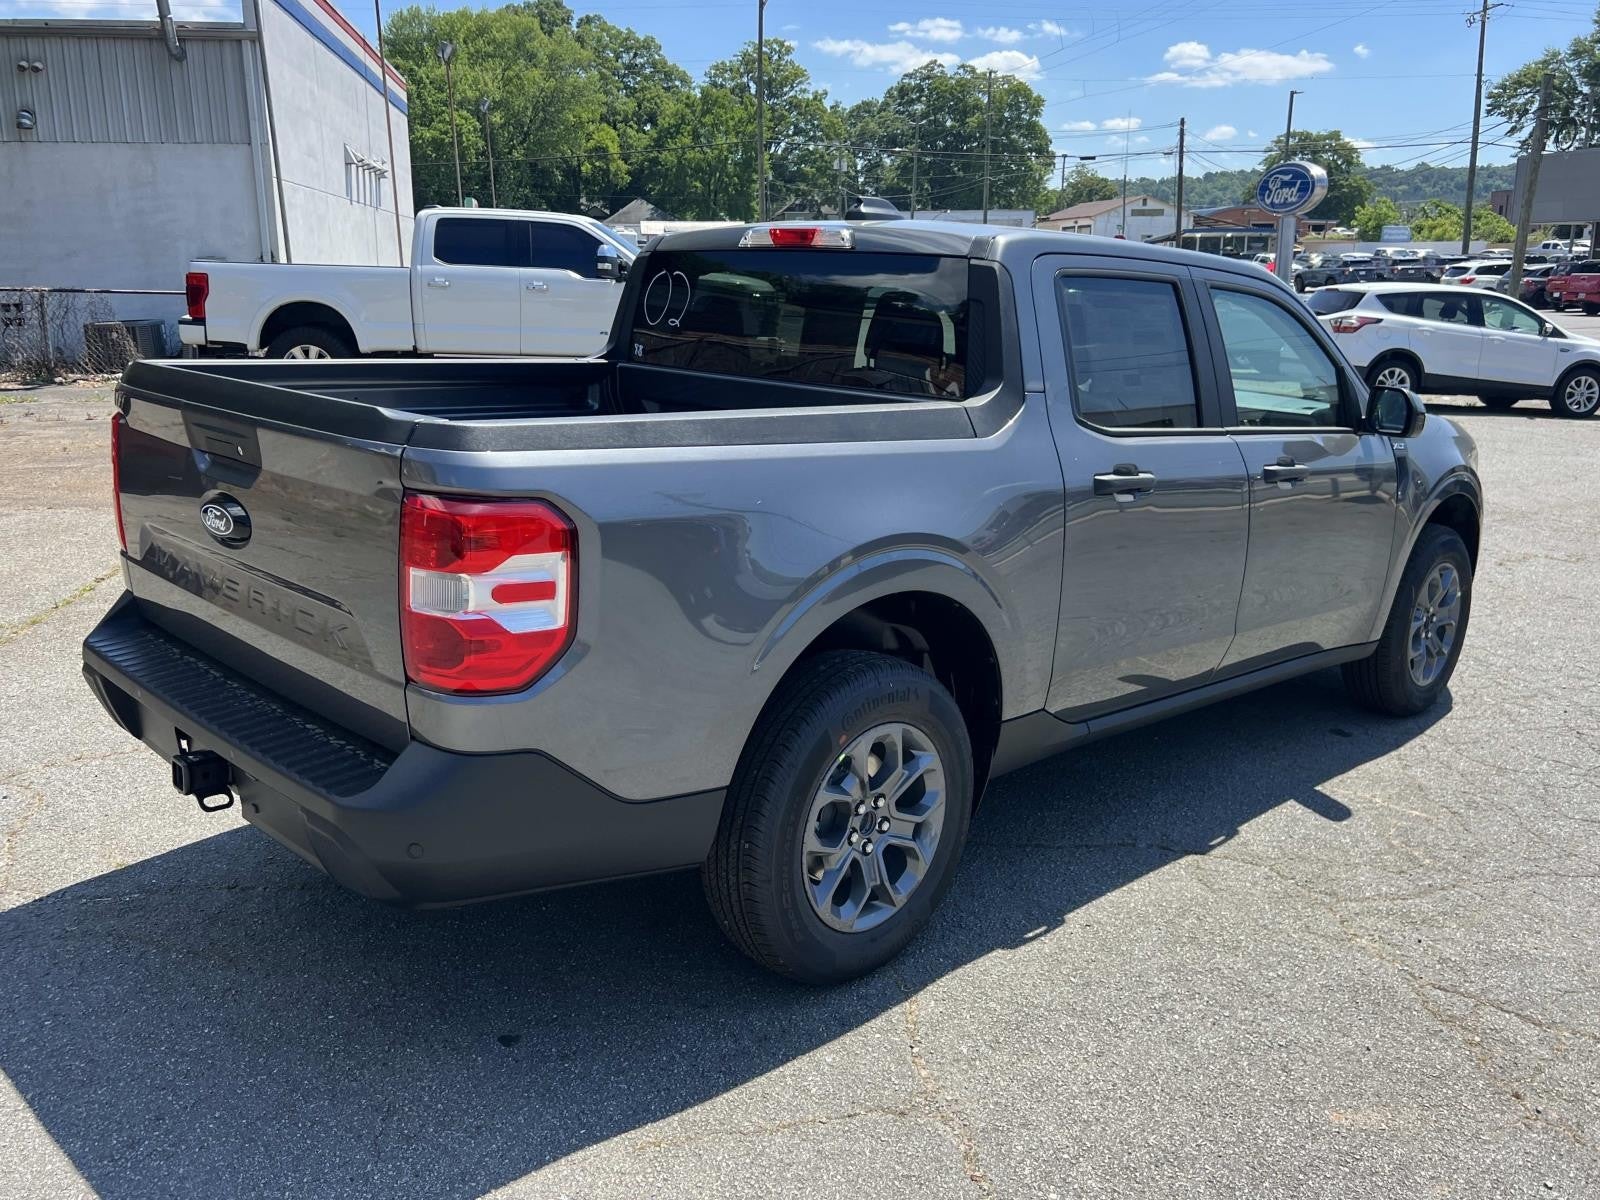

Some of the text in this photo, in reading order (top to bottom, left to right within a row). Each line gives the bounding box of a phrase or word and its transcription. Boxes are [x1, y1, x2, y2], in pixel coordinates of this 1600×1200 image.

[1265, 174, 1301, 205] Ford
[206, 507, 226, 531] Ford
[841, 687, 911, 731] Continental
